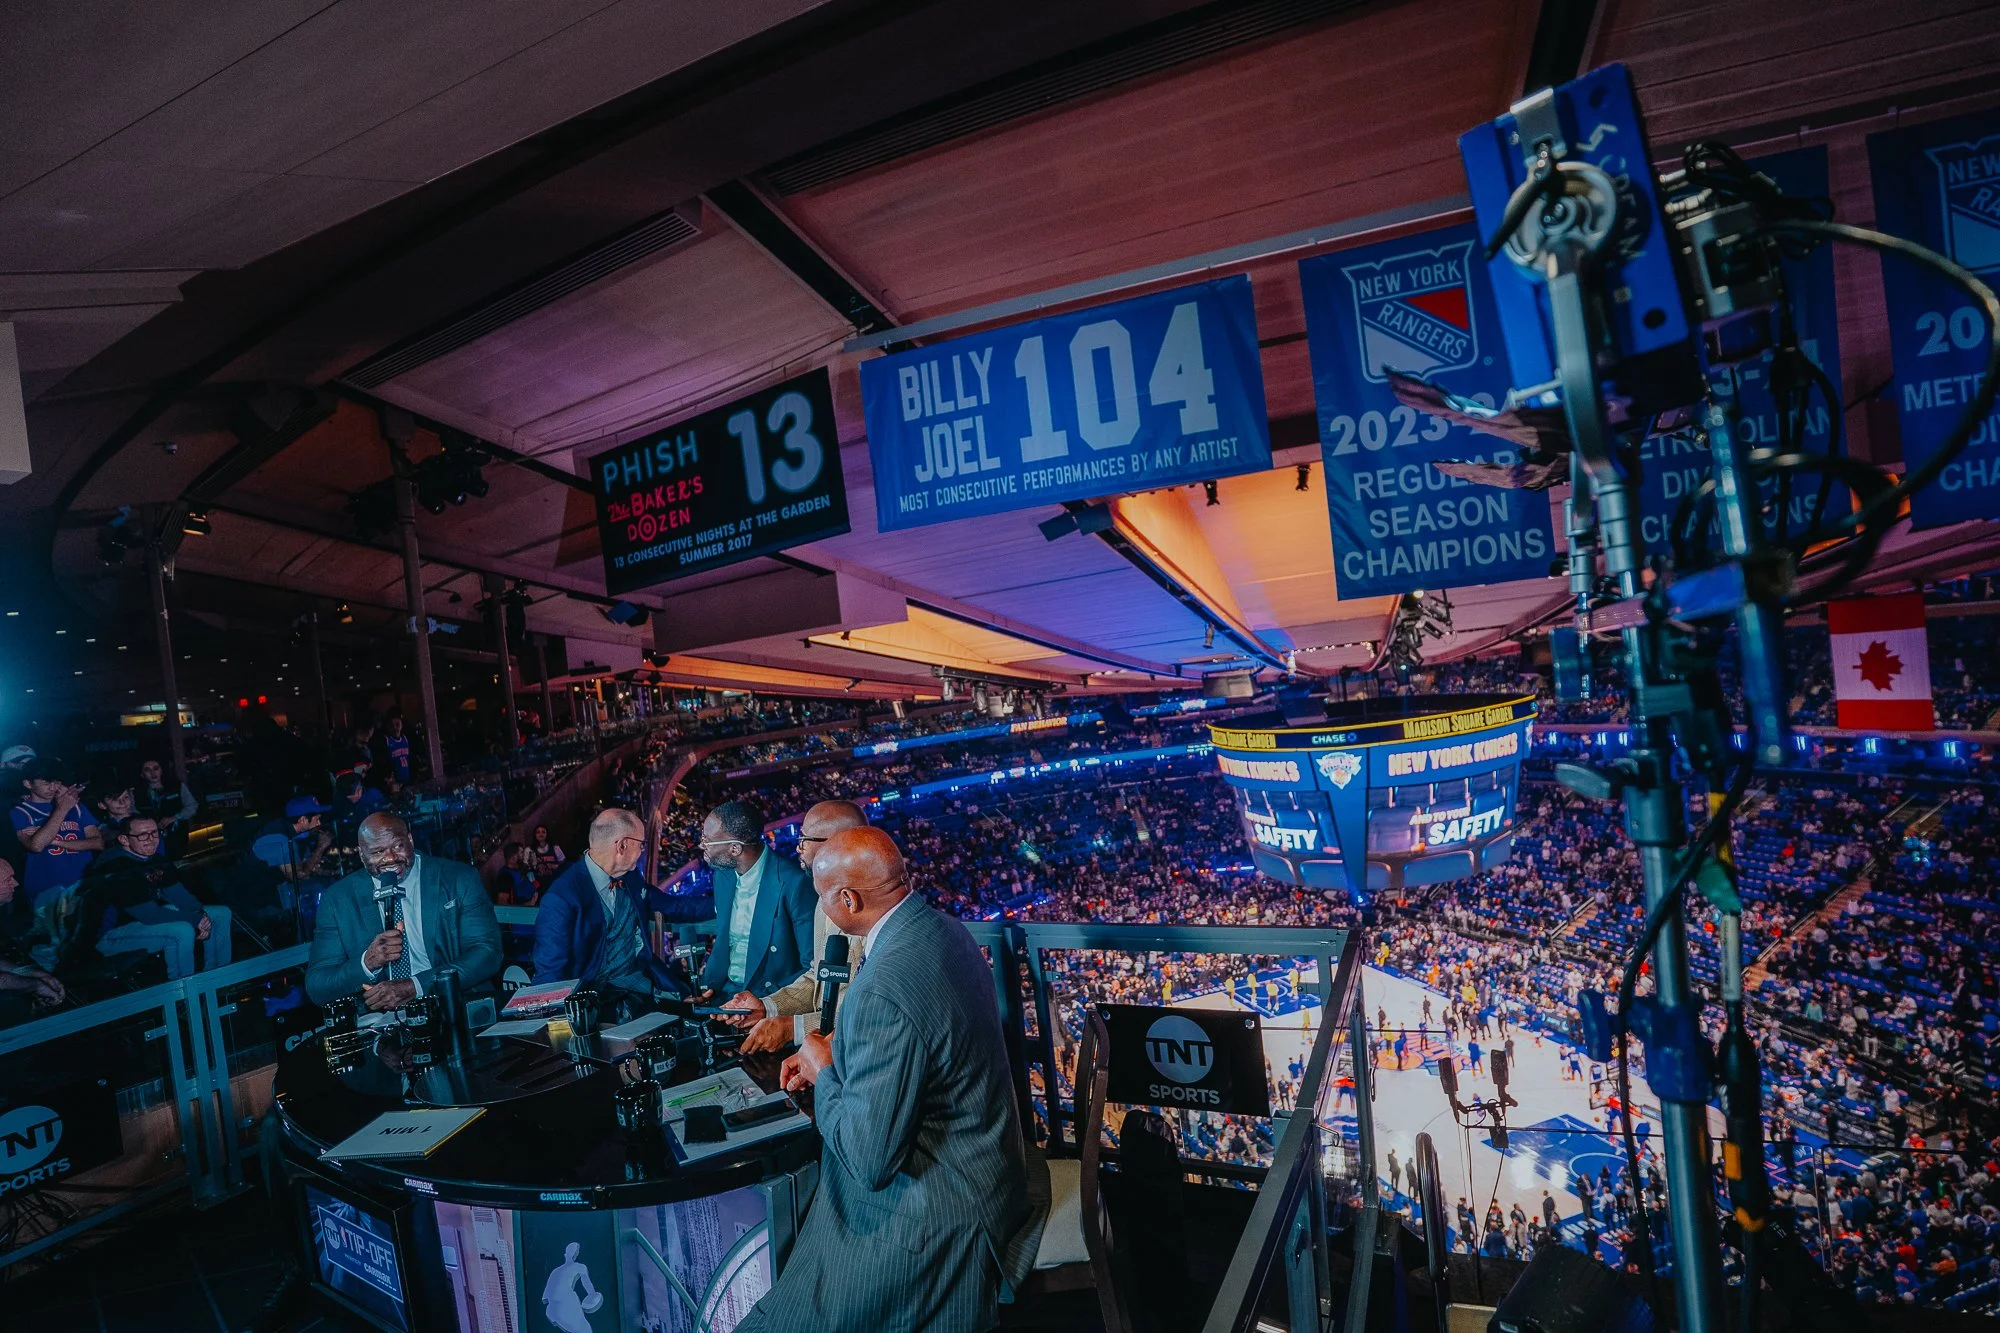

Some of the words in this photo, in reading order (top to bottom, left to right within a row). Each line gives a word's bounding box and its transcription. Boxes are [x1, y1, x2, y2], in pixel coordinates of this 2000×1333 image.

[1359, 272, 1401, 299] NEW
[1409, 260, 1463, 290] YORK
[1377, 304, 1468, 360] RANGERS
[898, 346, 994, 422] BILLY
[1014, 301, 1219, 463] 104
[603, 430, 698, 493] PHISH
[727, 391, 824, 502] 13
[915, 415, 1001, 483] JOEL
[630, 475, 703, 517] BAKER'S
[899, 494, 929, 513] MOST
[936, 475, 1017, 507] CONSECUTIVE
[1023, 456, 1125, 489] PERFORMANCES
[1132, 451, 1149, 472] BY
[1155, 447, 1182, 469] ANY
[1190, 437, 1239, 463] ARTIST
[614, 556, 625, 568] 13
[627, 536, 693, 565] CONSECUTIVE
[695, 524, 736, 544] NIGHTS
[739, 519, 752, 532] AT
[756, 509, 778, 527] THE
[781, 494, 831, 520] GARDEN
[627, 507, 690, 542] DOZEN
[1369, 491, 1509, 539] SEASON
[679, 544, 725, 566] SUMMER
[727, 534, 753, 552] 2017
[1343, 528, 1546, 580] CHAMPIONS
[1311, 733, 1347, 745] CHASE
[1403, 719, 1451, 739] MADISON
[1451, 711, 1485, 732] SQUARE
[1484, 705, 1514, 726] GARDEN
[1247, 761, 1301, 783] KNICKS
[1388, 751, 1428, 777] NEW
[1428, 744, 1474, 770] YORK
[1473, 732, 1518, 762] KNICKS
[1254, 823, 1318, 851] SAFETY
[1428, 804, 1505, 845] SAFETY
[1145, 1037, 1215, 1067] TNT
[1149, 1084, 1220, 1105] SPORTS
[345, 1228, 393, 1272] TIP-OFF
